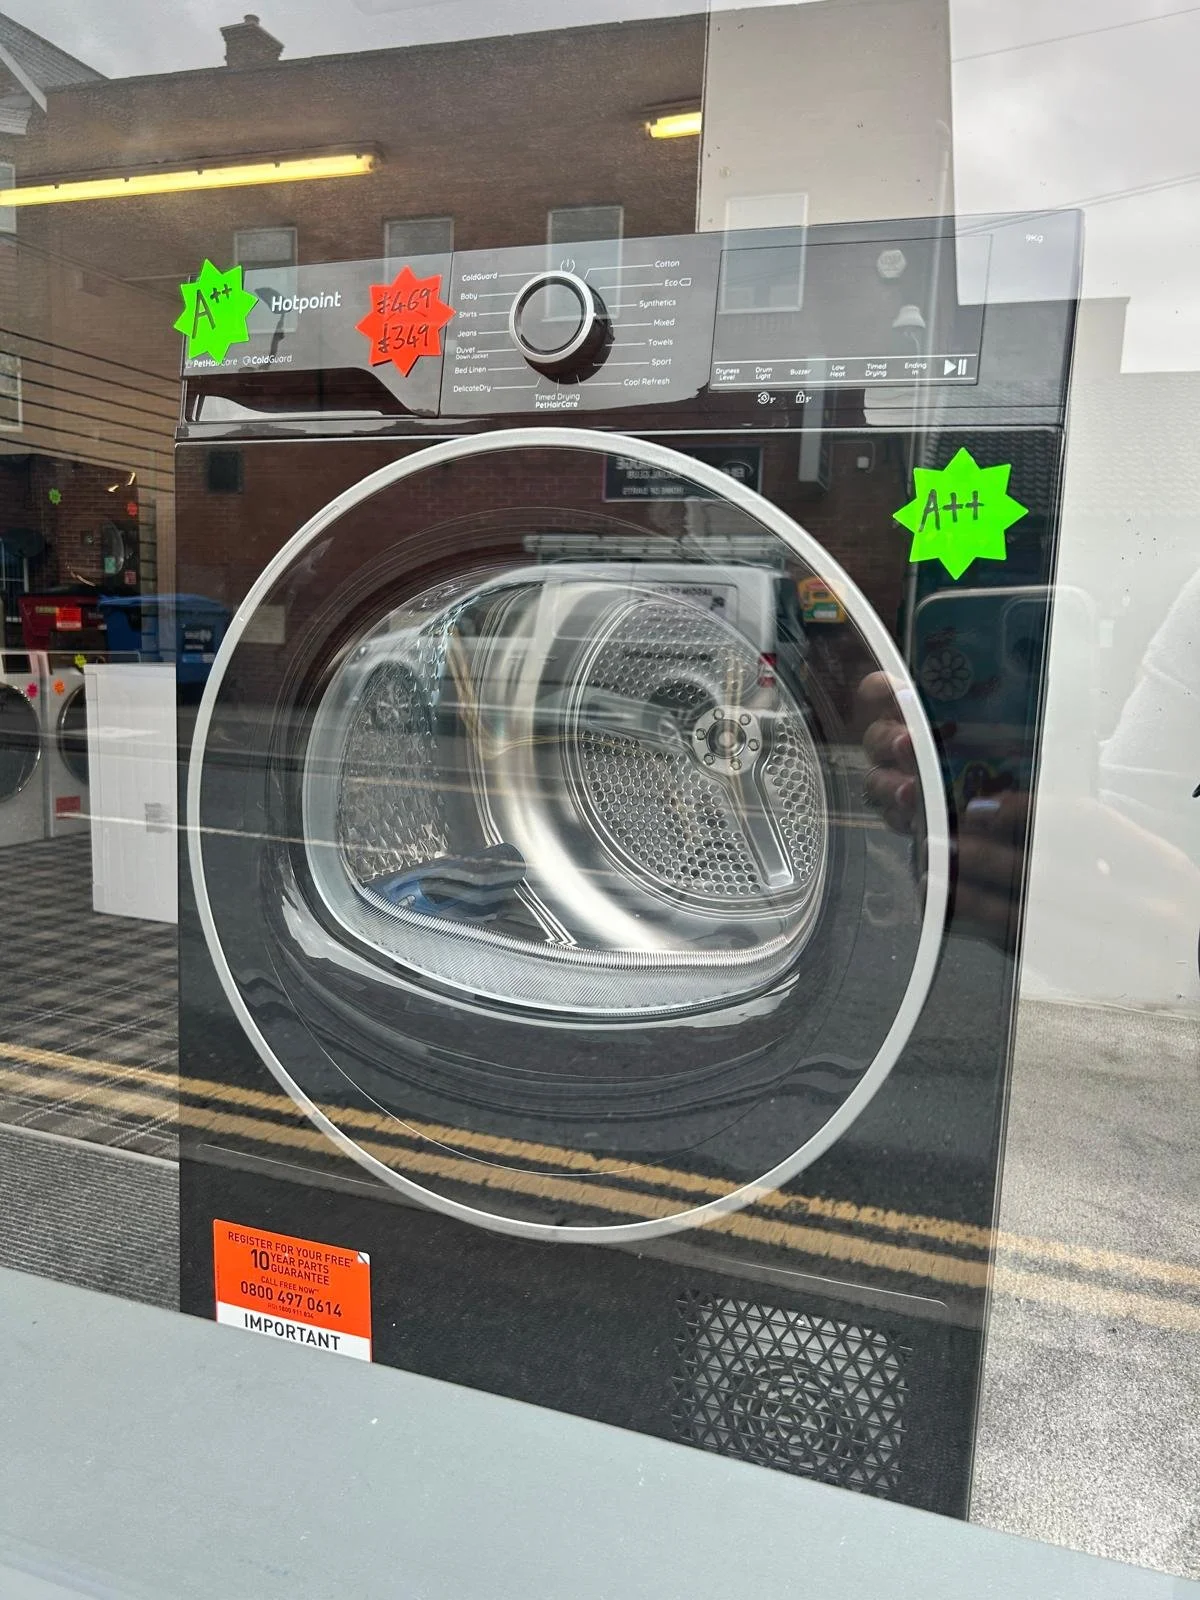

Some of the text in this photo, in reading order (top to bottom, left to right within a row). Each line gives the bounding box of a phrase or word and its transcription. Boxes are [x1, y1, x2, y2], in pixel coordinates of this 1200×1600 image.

[655, 259, 680, 268] Cotton
[462, 272, 498, 282] ColdGuard
[664, 279, 679, 287] Eco
[460, 292, 478, 301] Baby
[270, 291, 342, 314] Hotpoint
[639, 299, 677, 309] Synthetics
[191, 283, 233, 340] A++
[459, 311, 477, 319] Shirts
[653, 317, 676, 327] Mixed
[377, 322, 429, 353] £349
[457, 330, 477, 338] Jeans
[648, 338, 674, 347] Towels
[456, 346, 476, 354] Duvet
[251, 354, 293, 365] ColdGuard
[651, 358, 672, 367] Sport
[454, 366, 487, 375] Bed Linen
[904, 362, 927, 370] Ending
[715, 367, 740, 376] Dryness
[790, 368, 812, 376] Buzzer
[864, 370, 888, 378] Drying
[755, 373, 772, 381] Light
[623, 377, 671, 387] Cool Refresh
[453, 384, 492, 393] DelicateDry
[535, 392, 581, 402] Timed Drying
[535, 400, 579, 409] PetHairCare
[919, 488, 985, 533] A++
[228, 1231, 273, 1250] REGISTER
[275, 1242, 294, 1255] FOR
[296, 1246, 321, 1261] YOUR
[251, 1248, 329, 1274] 10 YEAR PARTS
[271, 1264, 330, 1285] GUARANTEE
[261, 1275, 278, 1287] CALL
[280, 1281, 297, 1291] FREE
[240, 1280, 273, 1301] 0800
[278, 1290, 303, 1307] 497
[307, 1296, 342, 1318] 0614
[244, 1313, 341, 1351] IMPORTANT
